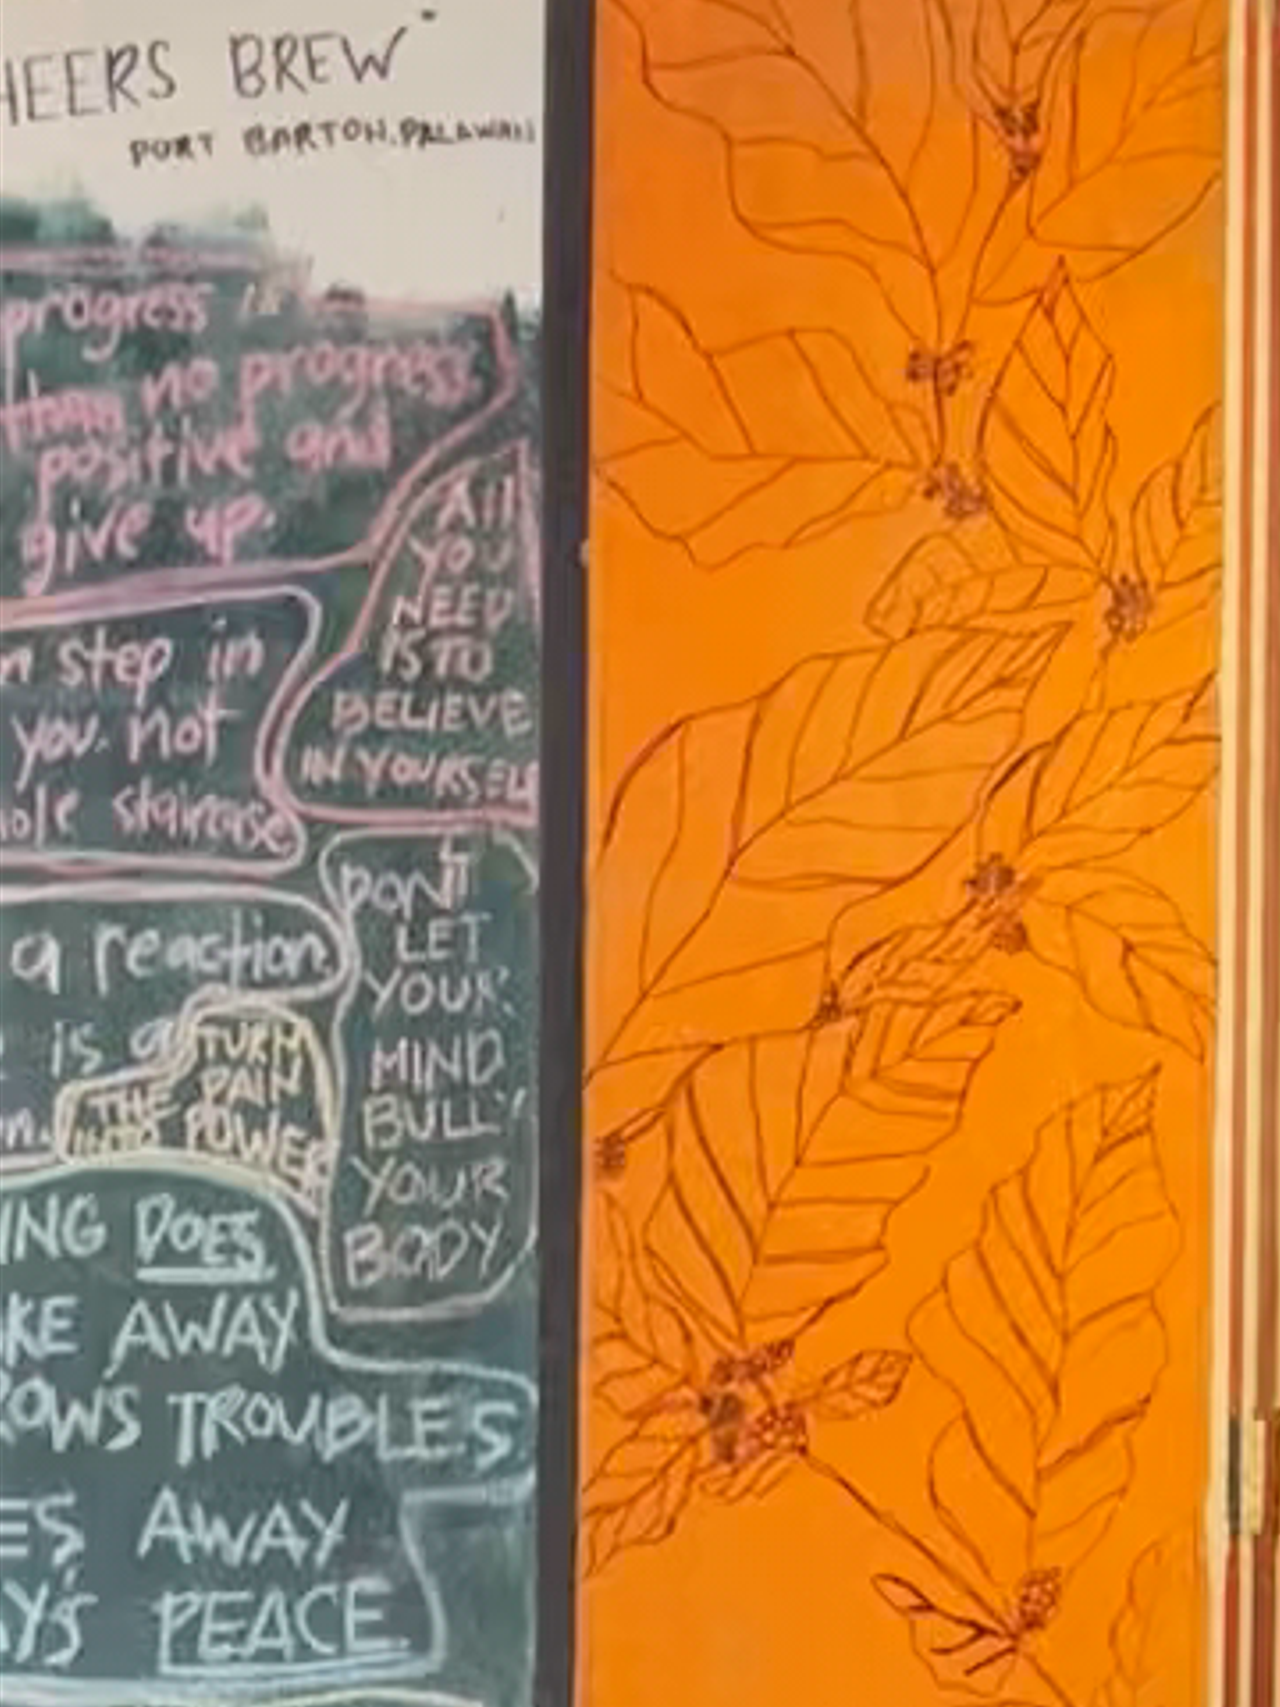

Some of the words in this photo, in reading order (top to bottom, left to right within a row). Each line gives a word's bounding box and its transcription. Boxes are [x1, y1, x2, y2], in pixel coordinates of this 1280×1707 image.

[130, 131, 215, 168] PORT
[141, 359, 220, 415] no
[22, 498, 155, 595] give
[394, 587, 514, 631] NEED
[58, 626, 175, 711] step
[208, 617, 264, 679] in
[128, 688, 242, 768] not
[331, 691, 533, 737] BELIEVE
[397, 913, 490, 962] LET
[371, 1035, 503, 1092] MIND
[352, 1156, 509, 1215] YOUR
[136, 1191, 270, 1275] DOES
[343, 1222, 502, 1289] BODY
[103, 1287, 300, 1380] AWAY
[137, 1486, 350, 1569] AWAY
[152, 1577, 410, 1661] PEACE
